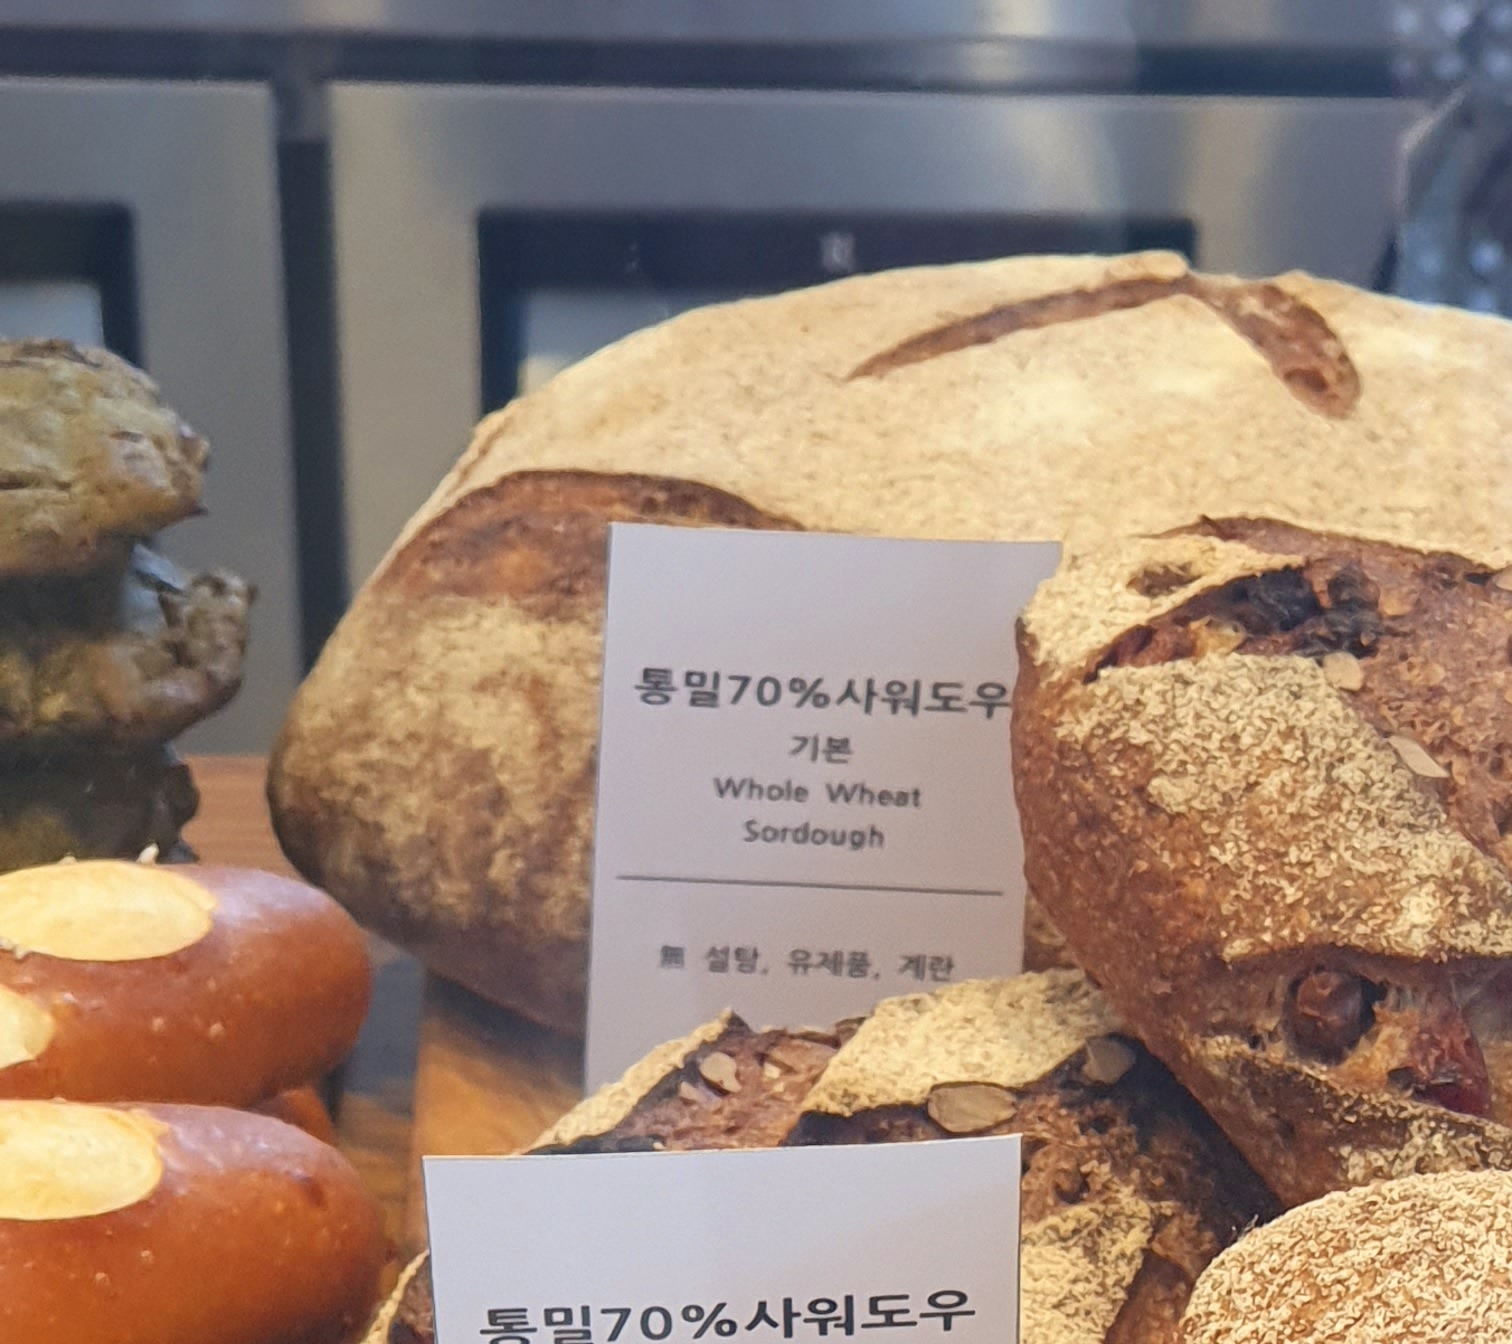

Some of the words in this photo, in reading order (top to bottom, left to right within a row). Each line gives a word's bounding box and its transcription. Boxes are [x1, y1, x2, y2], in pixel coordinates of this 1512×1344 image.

[634, 667, 1011, 719] 통밀70%사워도우
[790, 734, 853, 765] 기본
[713, 777, 809, 804] Whole
[825, 782, 922, 808] Wheat
[743, 819, 885, 852] Sordough
